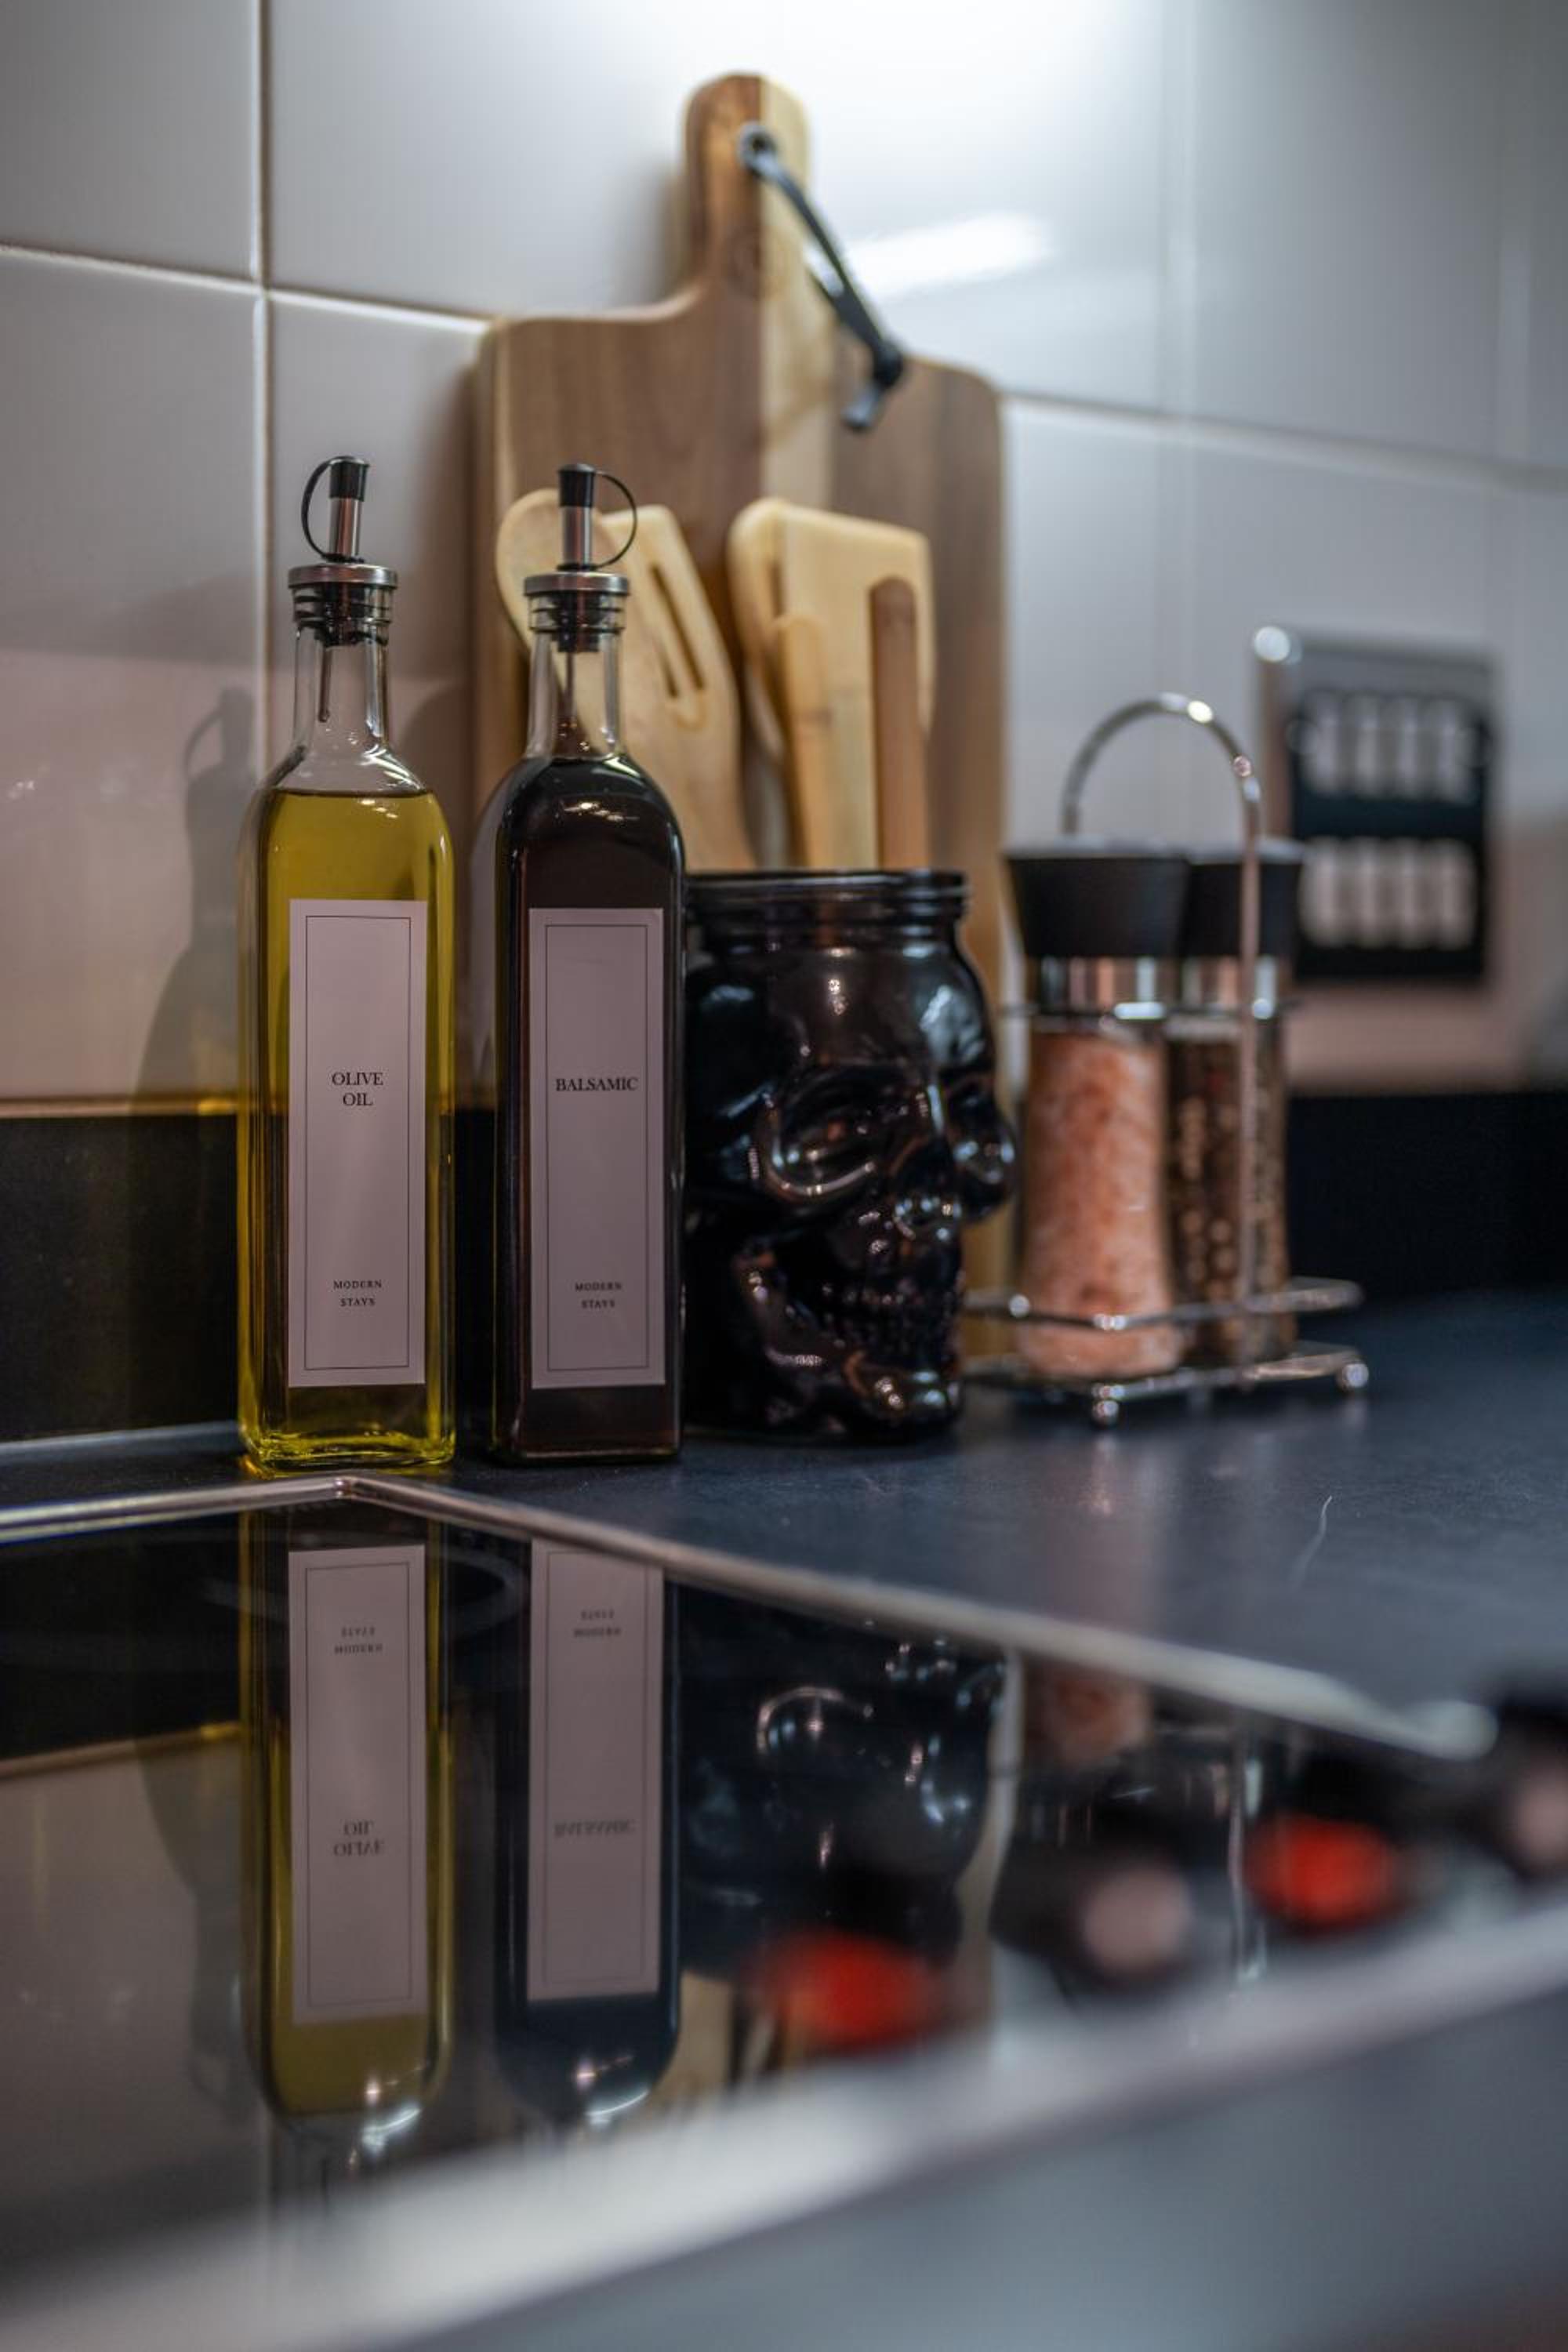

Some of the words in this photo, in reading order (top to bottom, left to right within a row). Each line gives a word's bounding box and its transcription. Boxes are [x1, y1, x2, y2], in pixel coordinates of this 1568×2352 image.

[332, 1072, 383, 1086] OLIVE
[556, 1076, 639, 1091] BALSAMIC
[343, 1092, 373, 1106] OIL
[333, 1279, 382, 1290] MODERN
[339, 1298, 376, 1307] STAYS
